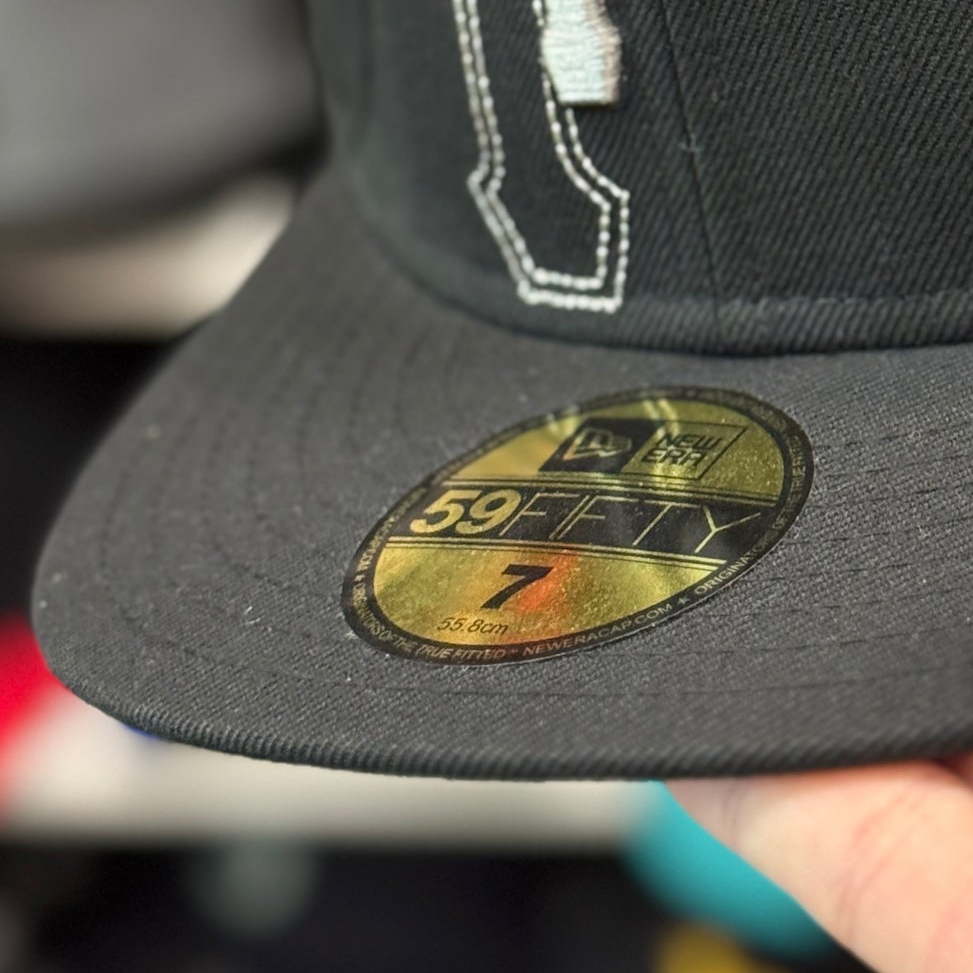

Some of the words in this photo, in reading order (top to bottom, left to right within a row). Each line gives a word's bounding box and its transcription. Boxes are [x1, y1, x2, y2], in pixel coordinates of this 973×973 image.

[641, 448, 707, 466] ERA
[656, 433, 722, 450] NEW
[410, 489, 761, 553] 59FIFTY
[480, 564, 554, 609] 7
[415, 642, 450, 660] TRUE
[523, 603, 673, 656] NEWERACAP.COM
[437, 618, 509, 635] 55.8cm
